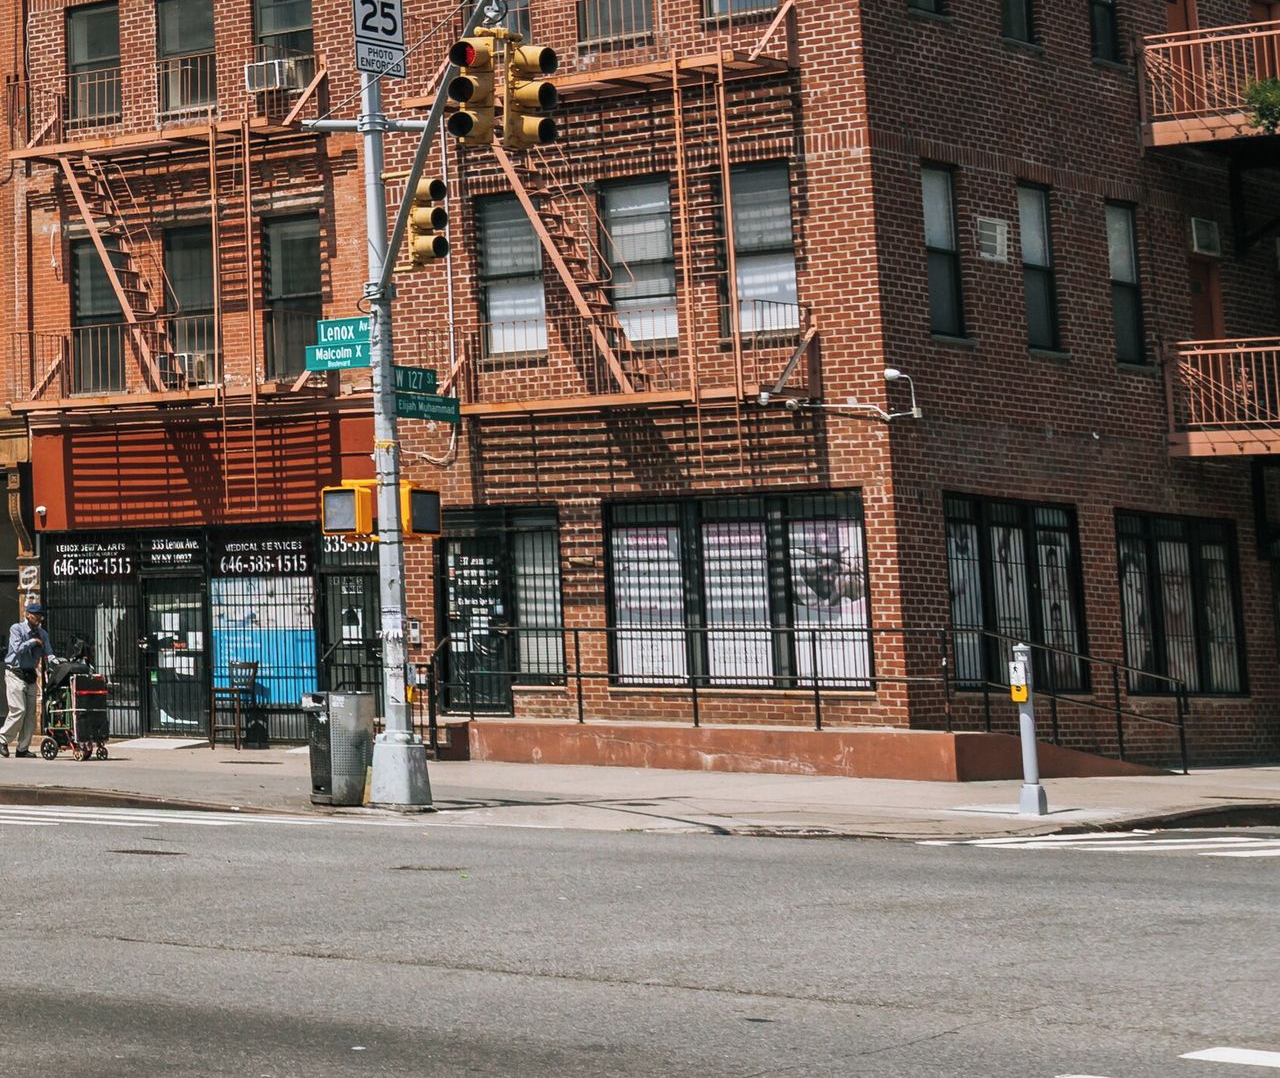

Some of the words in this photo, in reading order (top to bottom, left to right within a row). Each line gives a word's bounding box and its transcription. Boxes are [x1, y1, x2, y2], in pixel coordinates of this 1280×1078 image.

[367, 47, 394, 61] PHOTO
[360, 57, 402, 73] ENFORCED
[320, 324, 355, 342] Lenox
[315, 347, 353, 361] Malcolm
[355, 344, 362, 358] X
[395, 370, 403, 387] W
[408, 370, 423, 390] 127
[426, 373, 434, 385] St
[398, 399, 417, 413] Elijah
[418, 402, 455, 415] Muhammad
[224, 543, 258, 553] MEDICAL
[261, 540, 303, 552] SERVICES
[52, 557, 132, 577] 646-585-1515
[220, 554, 307, 574] 646-585-1515
